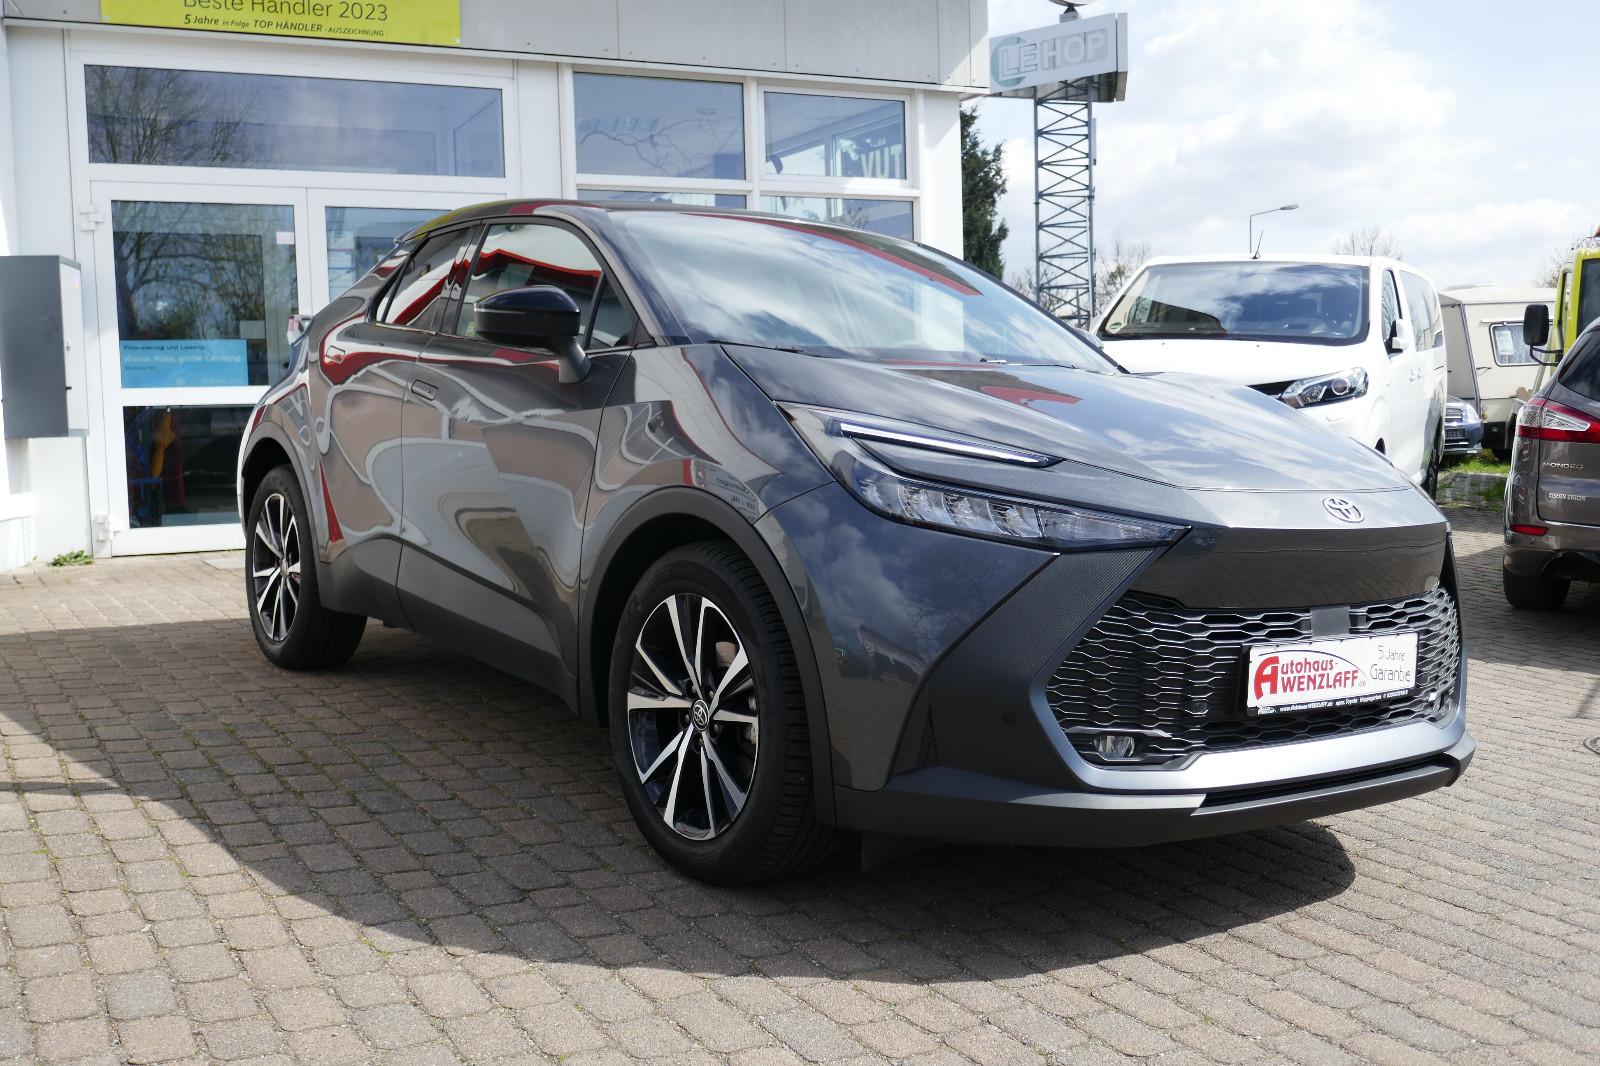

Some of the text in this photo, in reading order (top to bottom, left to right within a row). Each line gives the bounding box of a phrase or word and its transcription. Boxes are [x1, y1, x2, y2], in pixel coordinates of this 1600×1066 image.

[339, 1, 388, 21] 2023
[183, 14, 192, 25] 5
[193, 15, 220, 26] Jahre
[230, 19, 250, 29] Folge
[254, 19, 273, 29] TOP
[275, 20, 323, 33] HÄNDLER
[1377, 644, 1406, 662] 5 Jahre
[1369, 662, 1411, 683] Garantie
